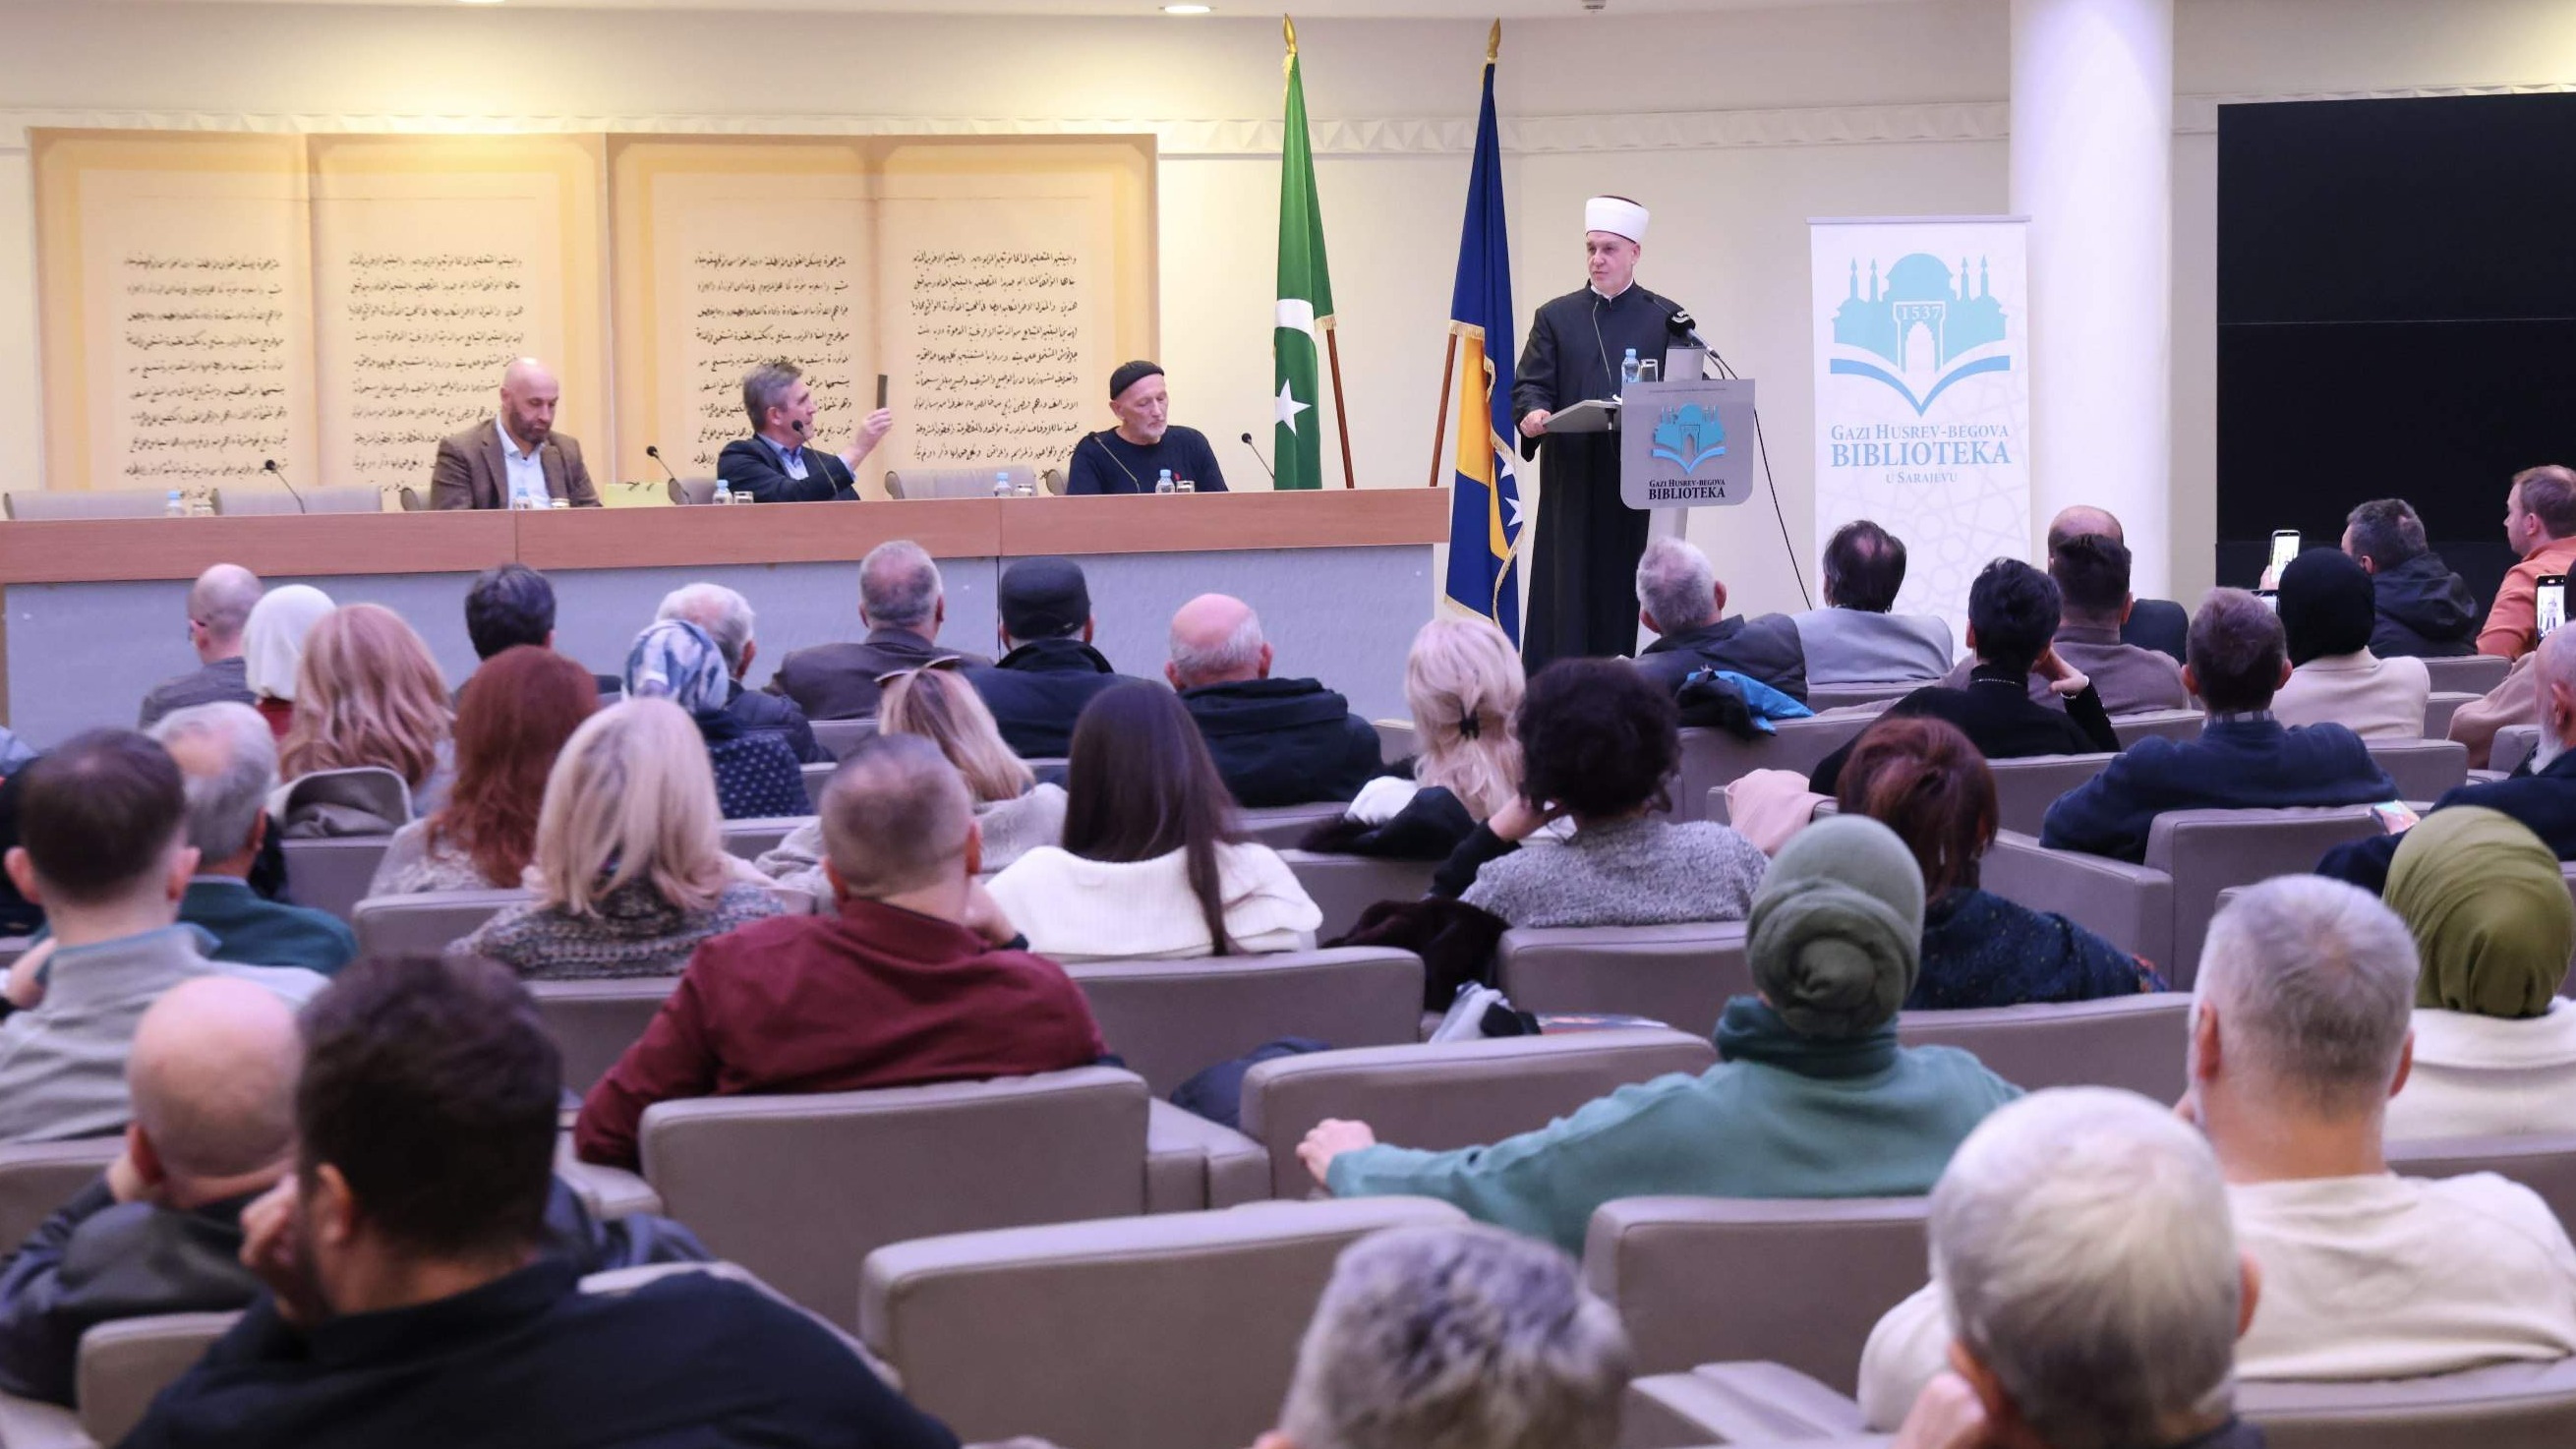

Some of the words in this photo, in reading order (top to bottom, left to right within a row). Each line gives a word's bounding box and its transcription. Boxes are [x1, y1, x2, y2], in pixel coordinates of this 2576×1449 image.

[1901, 306, 1942, 320] 1537
[1831, 440, 2012, 467] BIBLIOTEKA
[1649, 487, 1726, 499] BIBLIOTEKA
